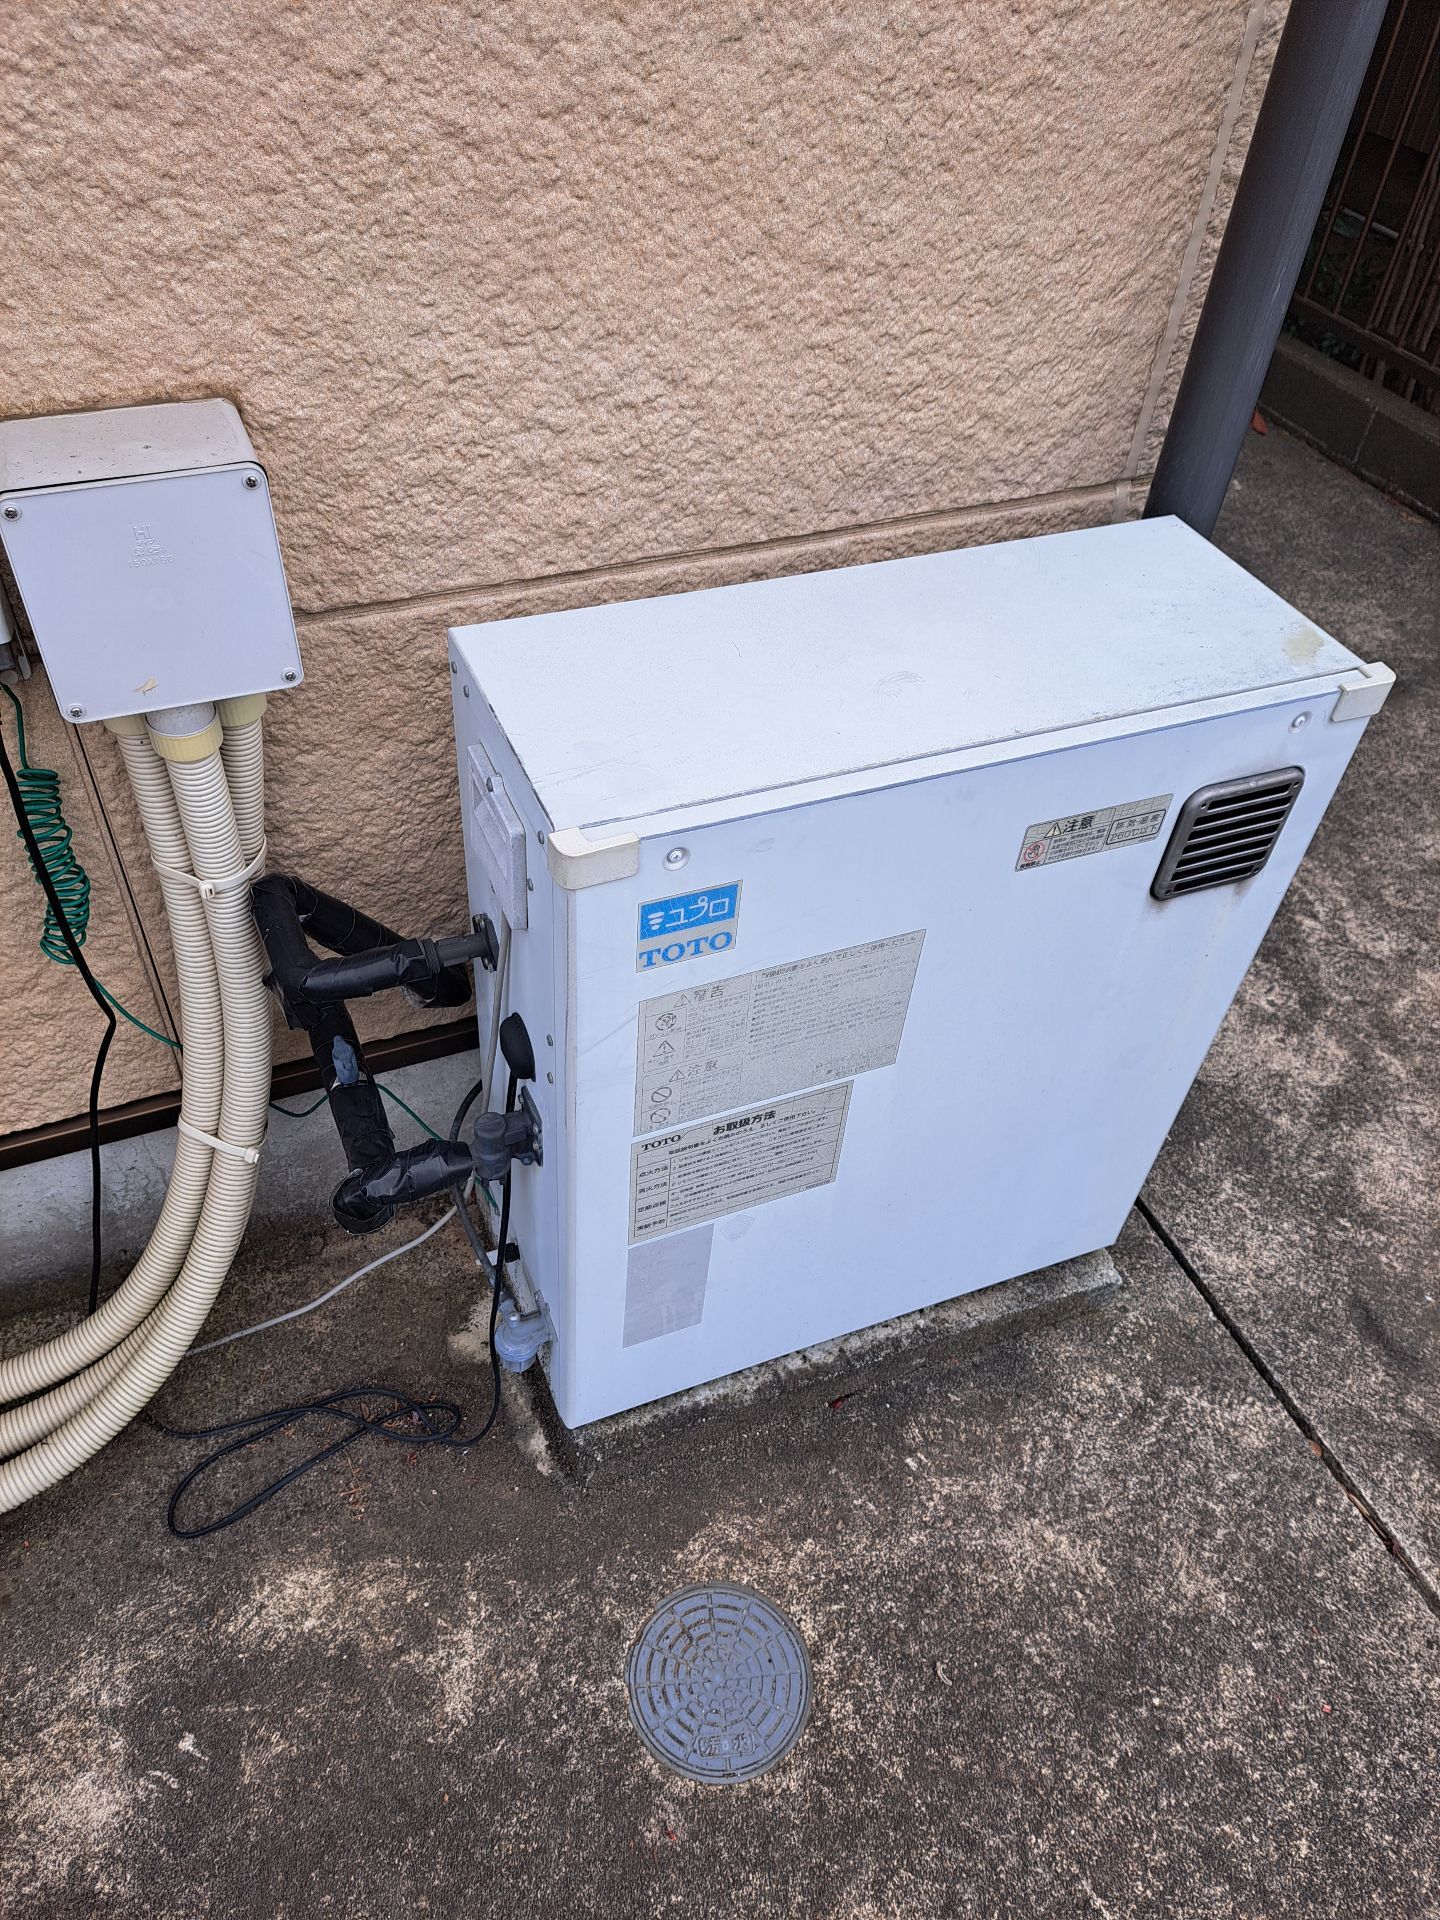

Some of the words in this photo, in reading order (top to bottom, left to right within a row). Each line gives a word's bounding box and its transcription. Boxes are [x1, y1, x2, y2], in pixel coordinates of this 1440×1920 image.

[1061, 814, 1096, 834] 注意
[1114, 813, 1161, 831] 排気温度
[638, 931, 732, 968] TOTO
[693, 982, 727, 1003] 警告
[712, 1108, 777, 1136] お取扱方法
[641, 1133, 681, 1152] TOTO
[638, 1163, 669, 1179] 点火方法
